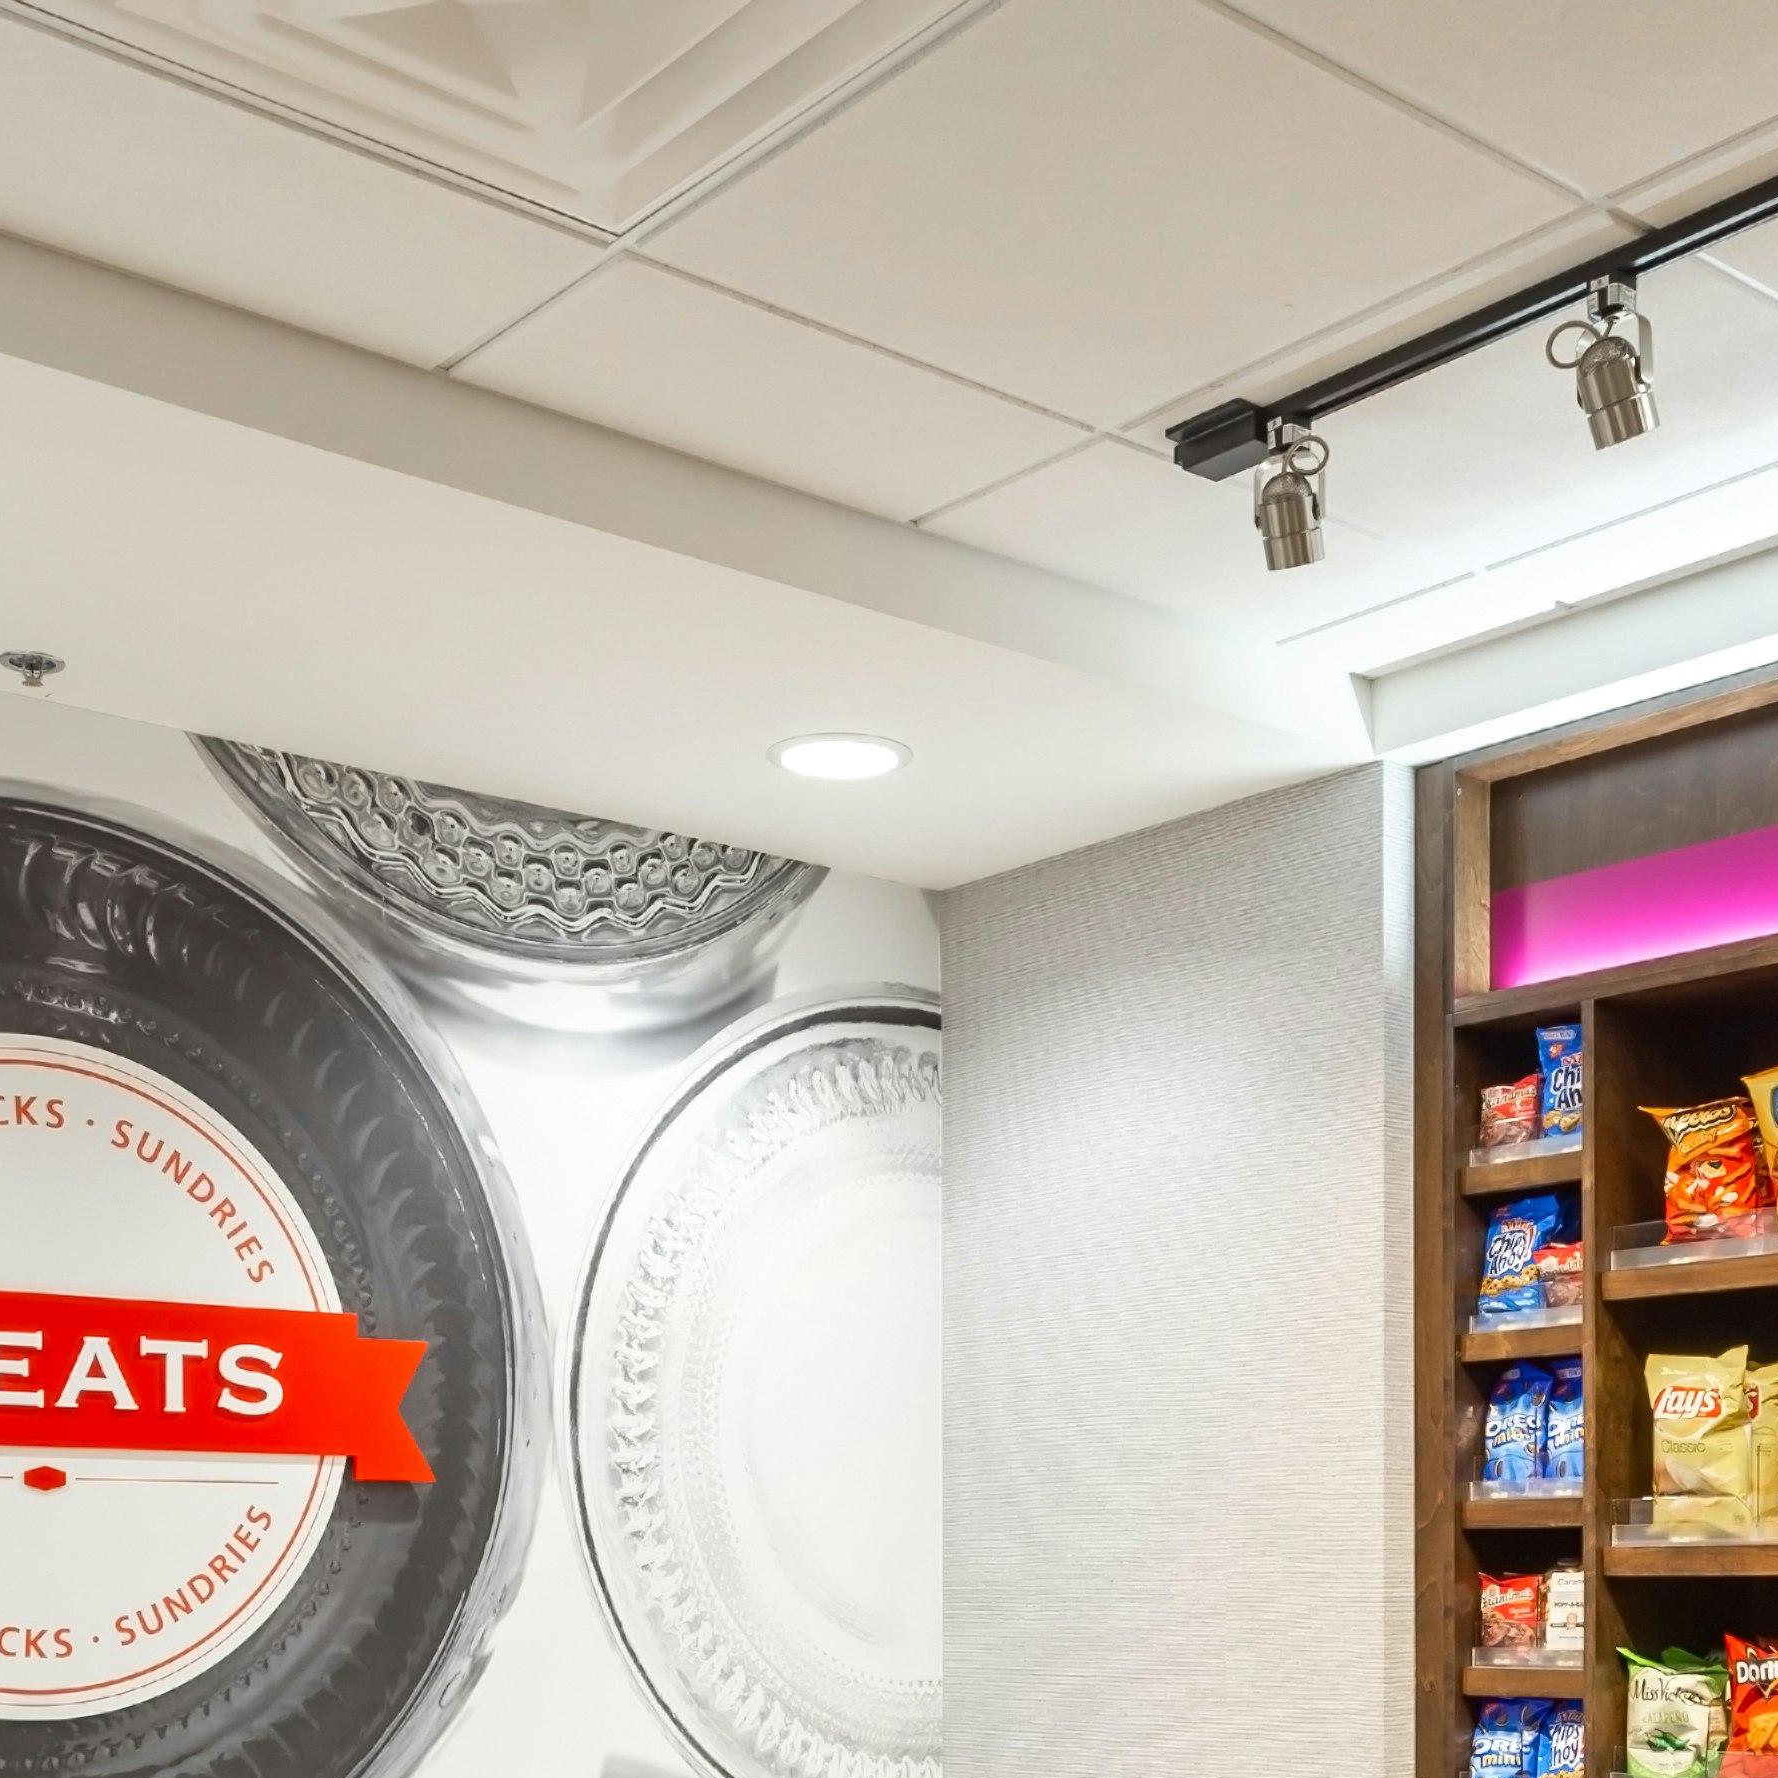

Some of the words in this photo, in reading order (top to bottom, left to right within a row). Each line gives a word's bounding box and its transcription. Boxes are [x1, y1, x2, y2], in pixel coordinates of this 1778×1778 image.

[112, 1119, 276, 1286] SUNDRIES
[1661, 1440, 1707, 1454] Classic
[116, 1504, 274, 1647] SUNDRIES
[1483, 1754, 1521, 1767] mini
